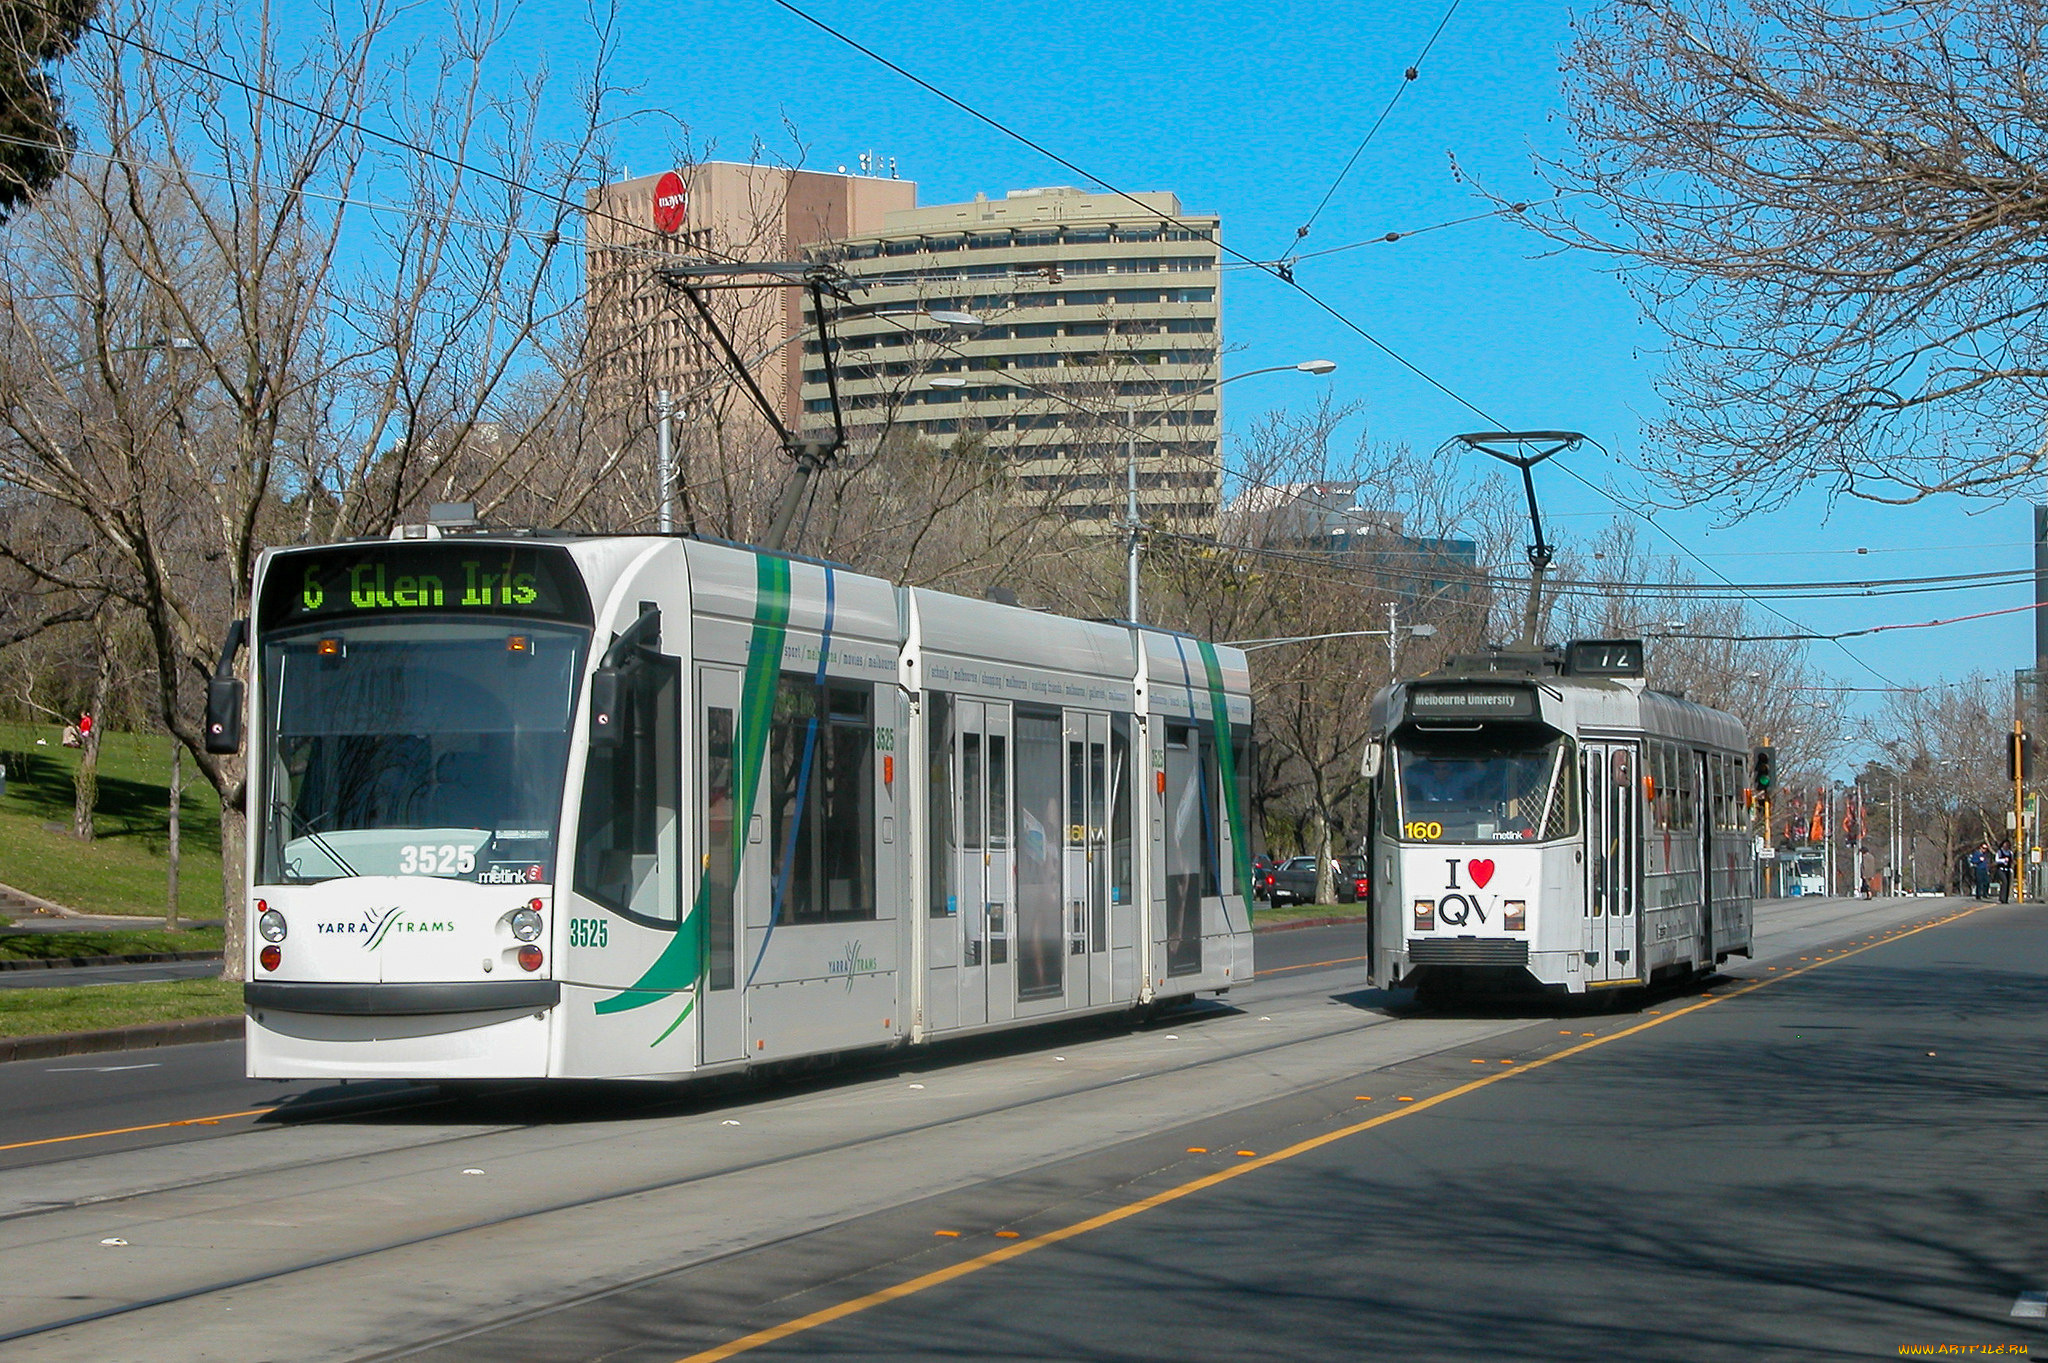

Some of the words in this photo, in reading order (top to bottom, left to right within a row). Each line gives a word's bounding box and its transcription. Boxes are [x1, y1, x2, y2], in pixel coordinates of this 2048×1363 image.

[303, 564, 323, 609] 6
[351, 563, 443, 608] Glen
[461, 561, 538, 605] Iris
[843, 653, 863, 668] movies
[868, 654, 897, 671] melbourne
[1599, 646, 1629, 668] 72
[1415, 693, 1465, 705] Melbourne
[1467, 693, 1516, 707] University
[876, 726, 894, 751] 3525
[1404, 821, 1443, 839] 160
[399, 845, 476, 875] 3525
[478, 868, 528, 884] metlink
[1445, 859, 1461, 889] I
[1439, 893, 1498, 927] QV
[317, 922, 369, 934] YARRA
[397, 921, 455, 932] TRAMS
[569, 918, 608, 948] 3525
[828, 959, 849, 974] YARRA
